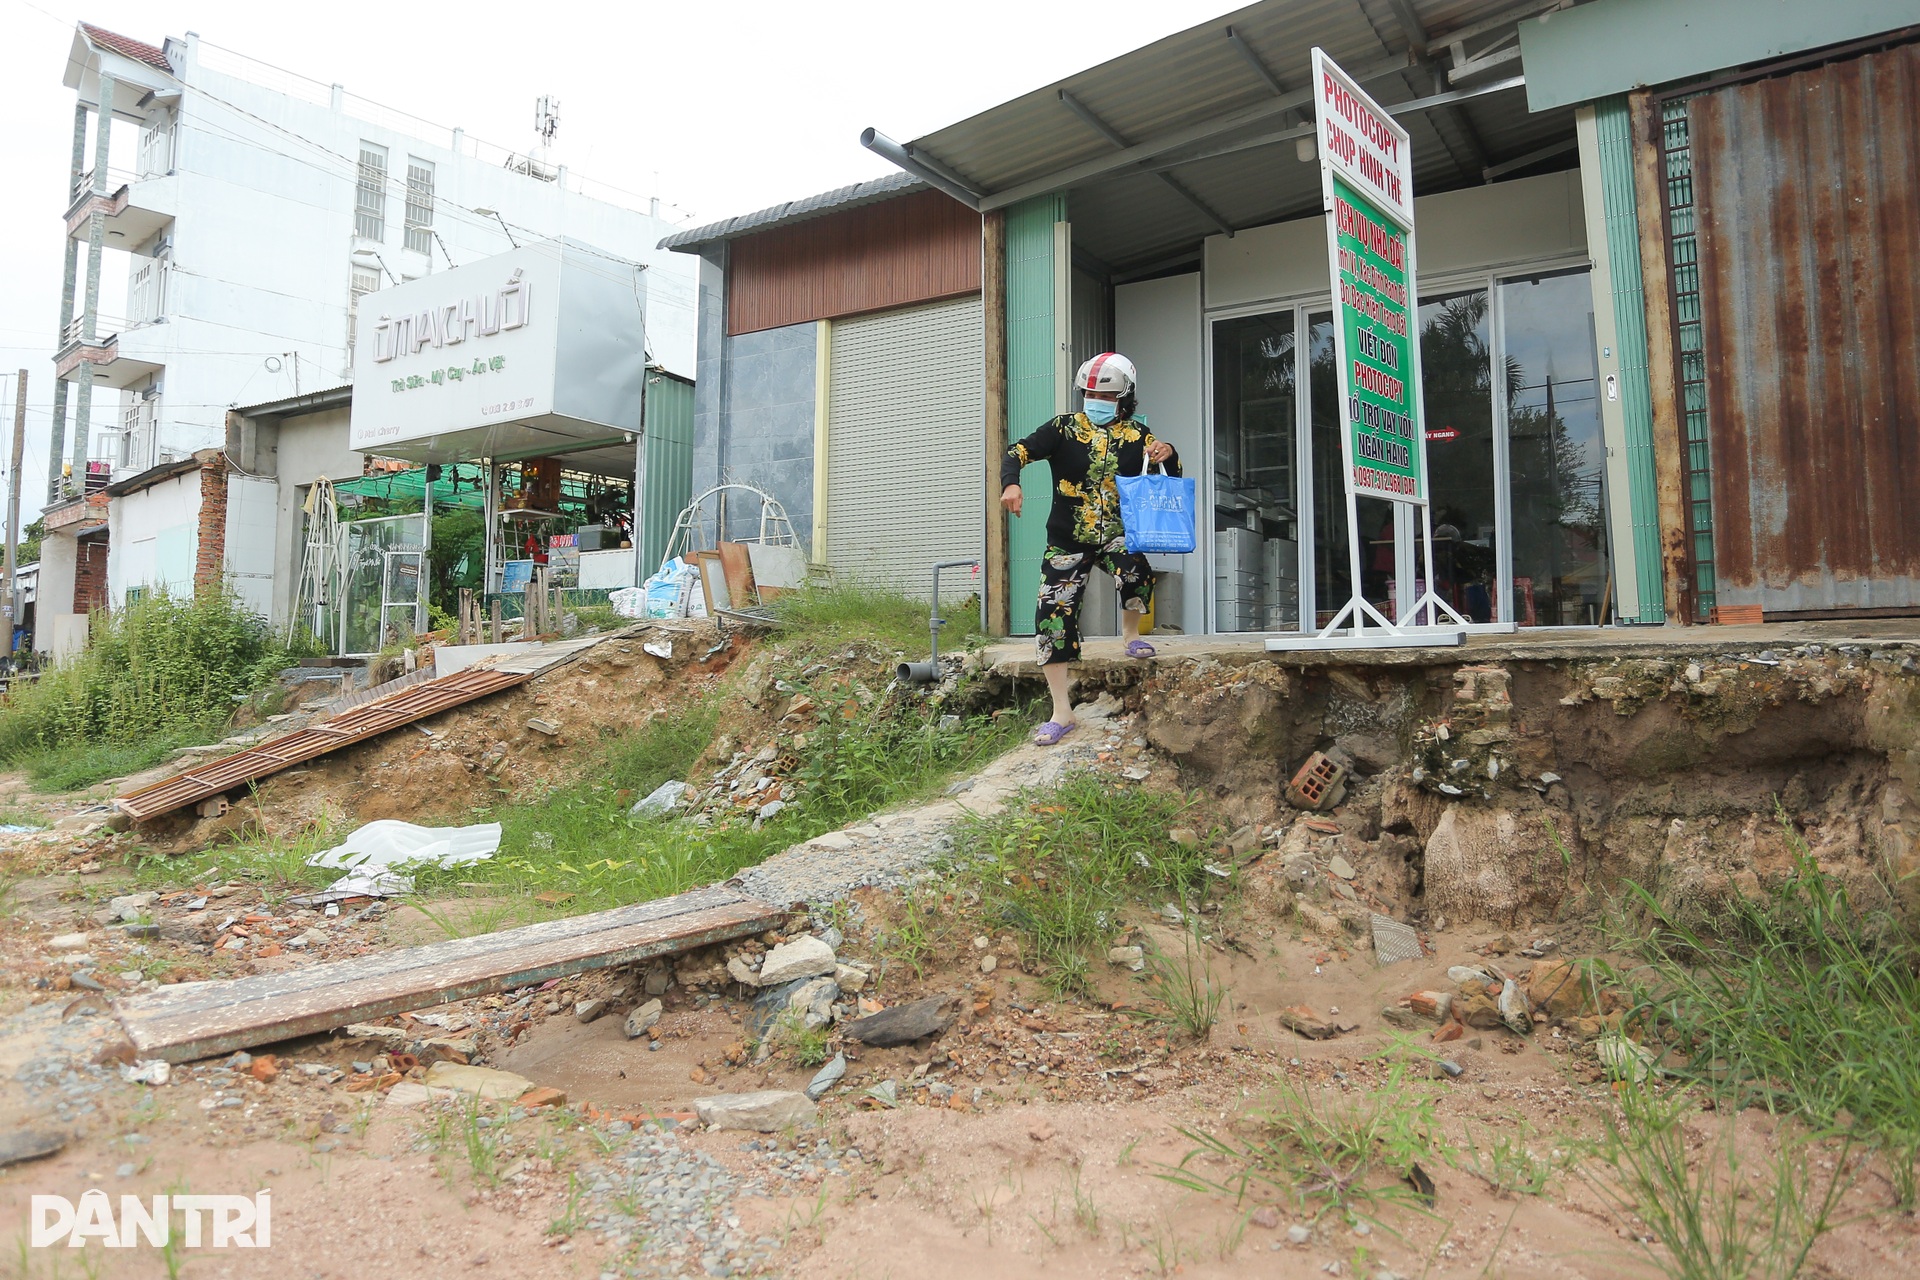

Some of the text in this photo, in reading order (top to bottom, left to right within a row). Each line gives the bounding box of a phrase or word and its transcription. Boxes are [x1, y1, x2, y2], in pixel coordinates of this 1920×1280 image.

[1323, 72, 1397, 164] PHOTOCOPY
[1326, 118, 1403, 207] CHỤP HÌNH THẺ
[1335, 195, 1405, 274] ỊCH VỤ NHÀ ĐẤT
[1357, 326, 1398, 371] VIẾT ĐƠN
[391, 379, 405, 394] Trà
[447, 366, 465, 382] Cay
[1354, 359, 1404, 405] PHOTOCOPY
[1361, 400, 1380, 435] TRỢ
[1381, 408, 1396, 436] VAY
[1397, 410, 1415, 441] VỐN
[1357, 431, 1409, 469] NGÂN HÀNG
